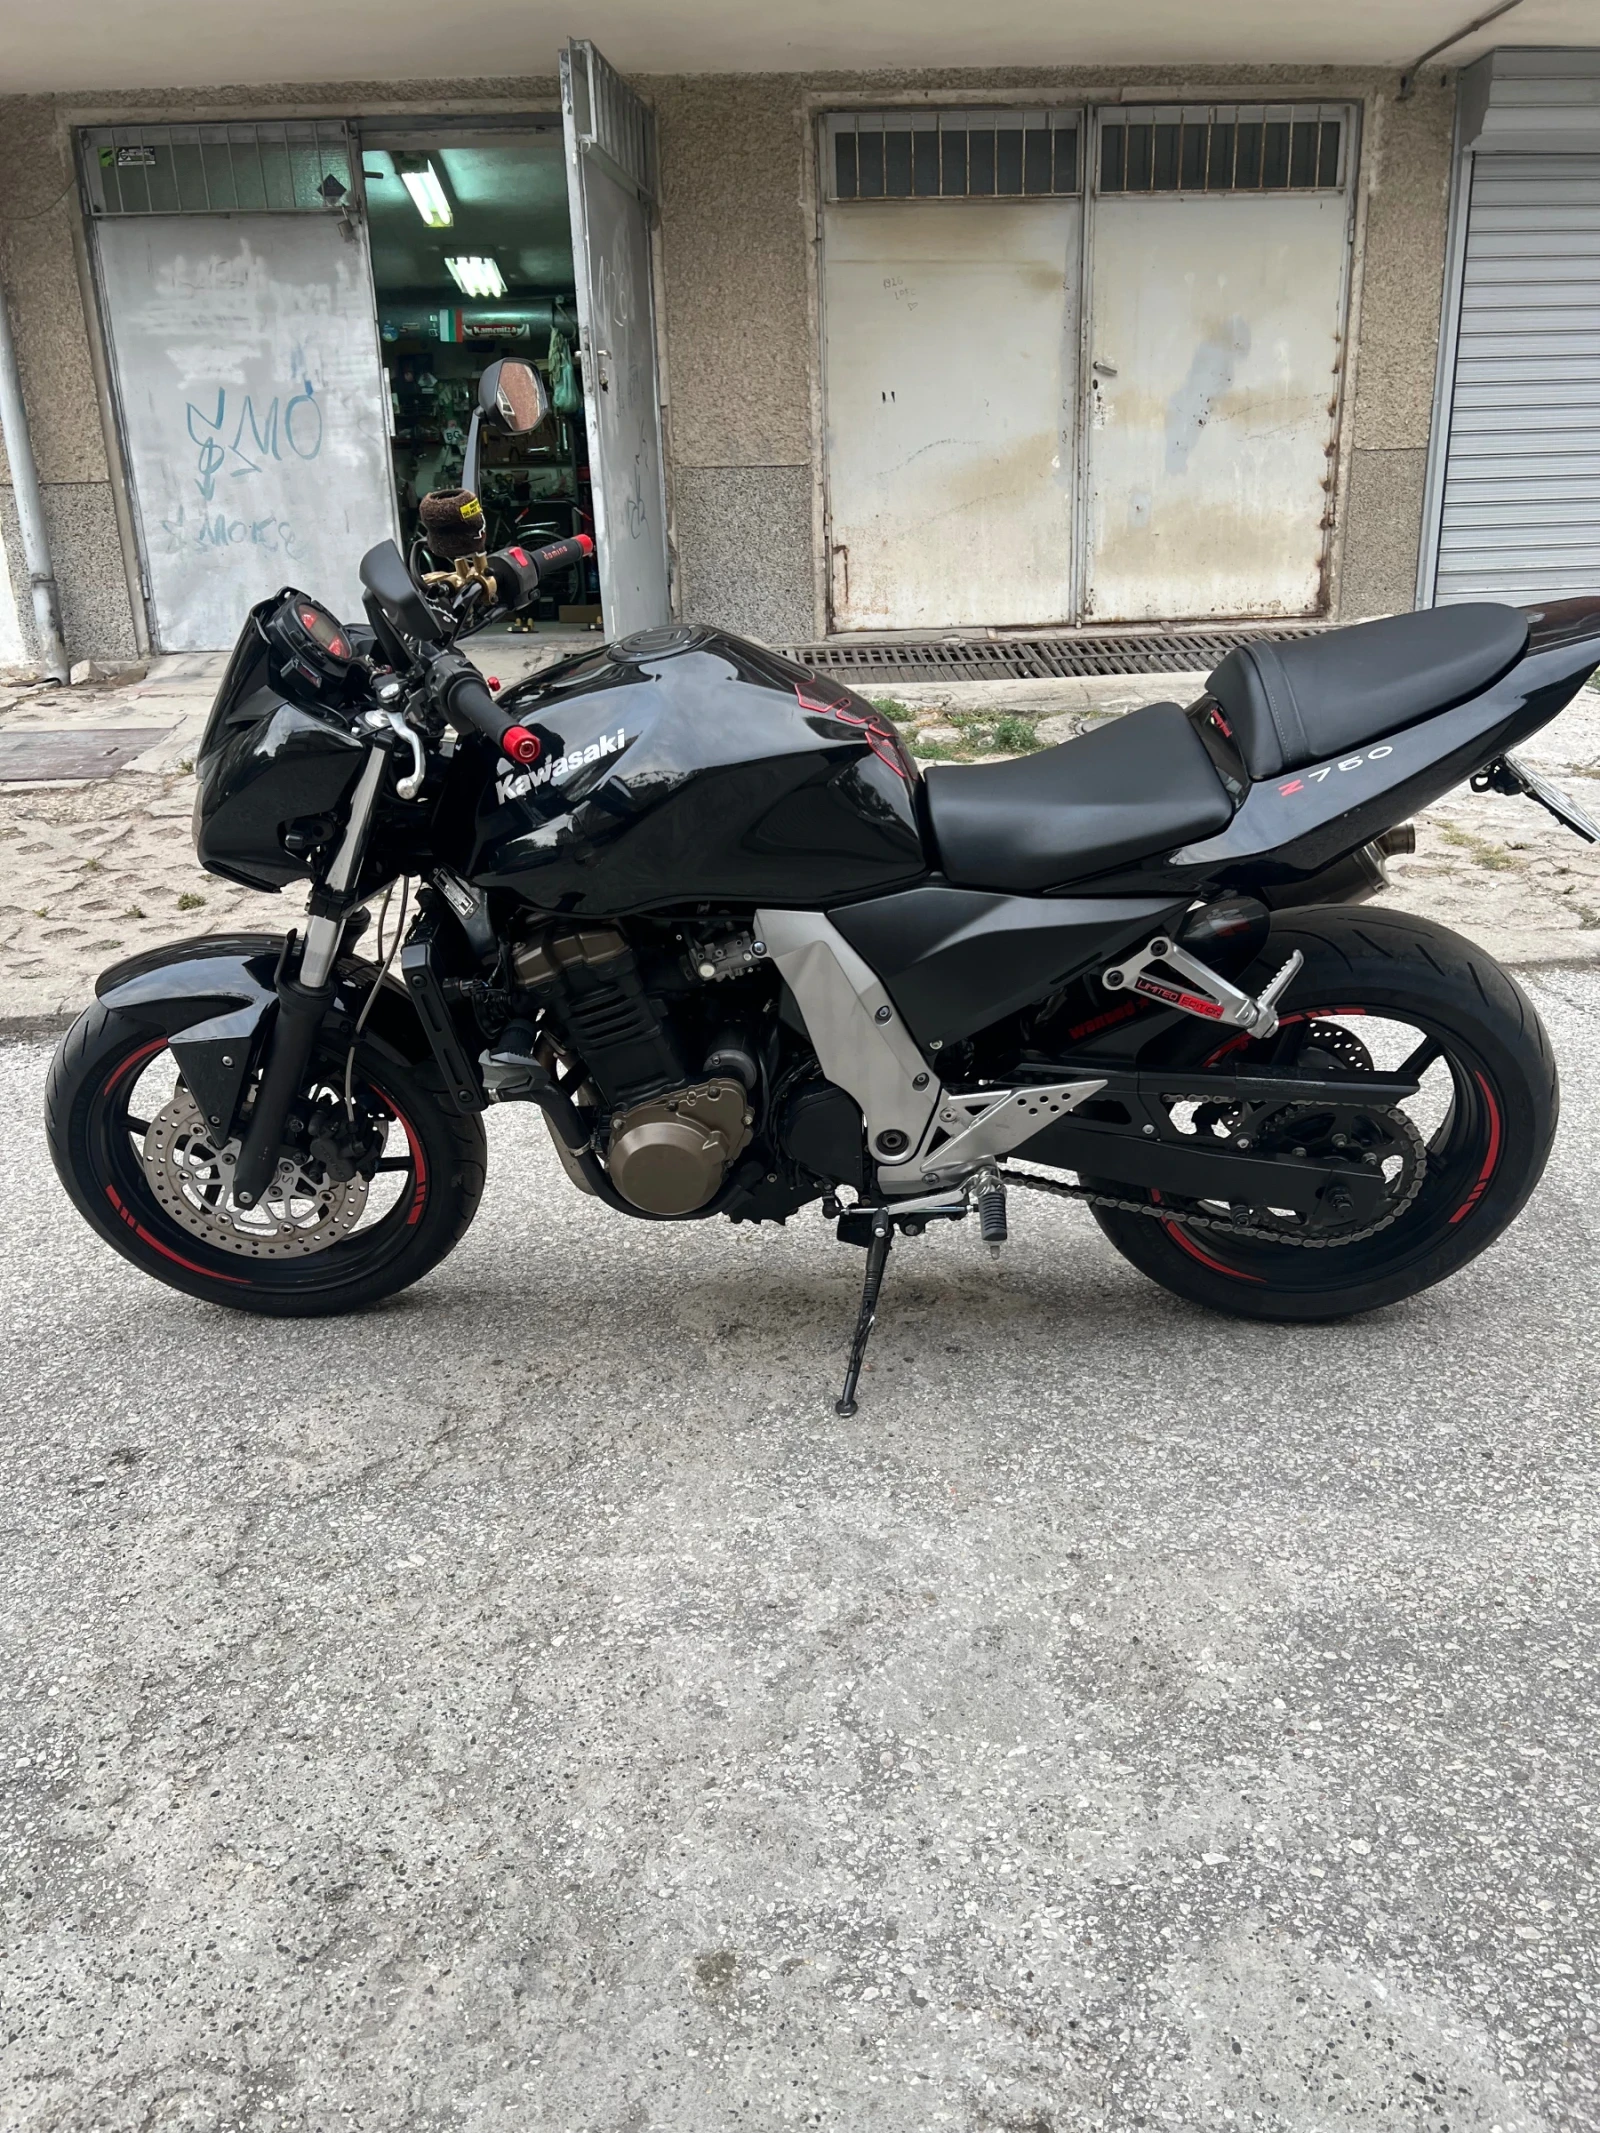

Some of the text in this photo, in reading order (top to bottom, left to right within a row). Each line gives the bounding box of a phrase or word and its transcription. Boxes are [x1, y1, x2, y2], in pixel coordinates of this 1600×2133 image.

[446, 430, 462, 441] BG
[541, 545, 568, 560] domino
[495, 728, 625, 805] Kawasaki
[1137, 980, 1178, 1001] LIMITED
